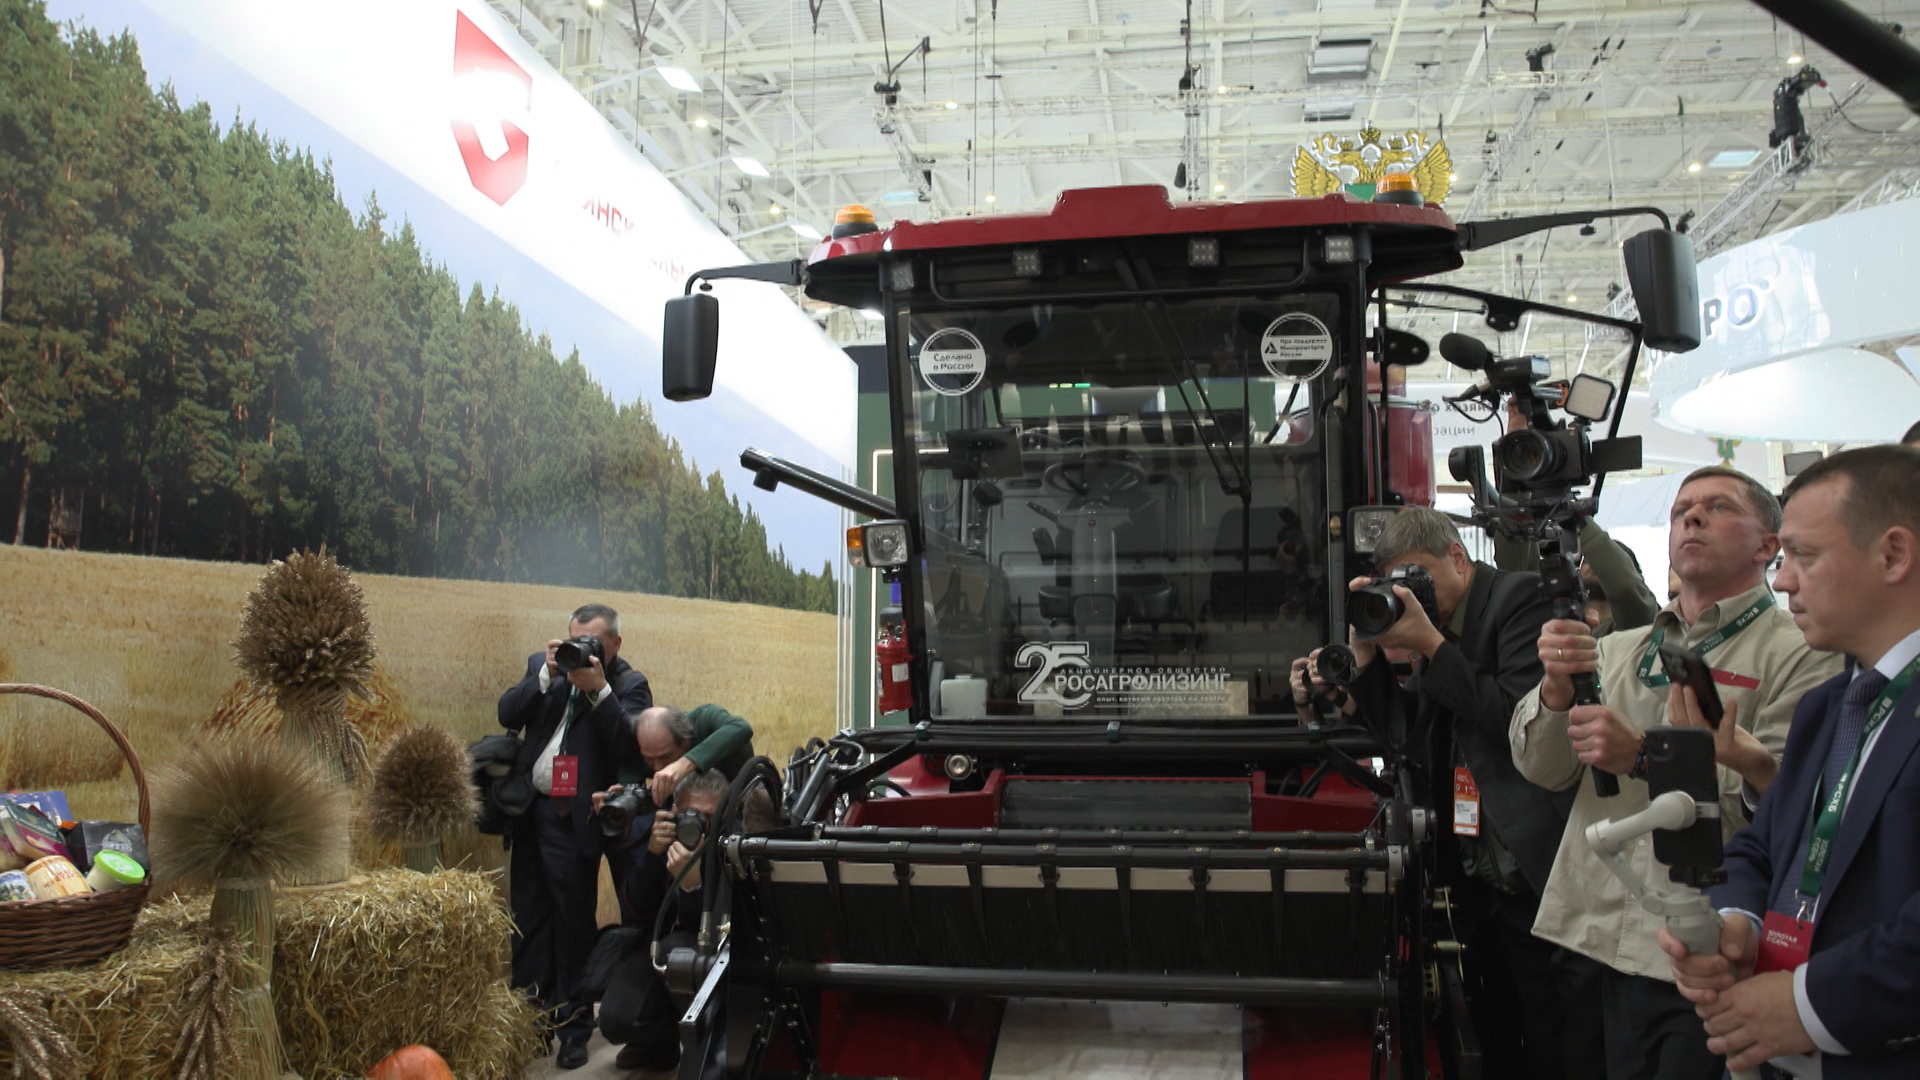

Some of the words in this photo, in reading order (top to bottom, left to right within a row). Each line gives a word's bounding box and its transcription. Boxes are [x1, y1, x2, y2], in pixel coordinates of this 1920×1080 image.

[933, 353, 973, 362] Сделано
[1015, 641, 1091, 710] 25
[1055, 673, 1231, 692] РОСАГРОЛИЗИНГ
